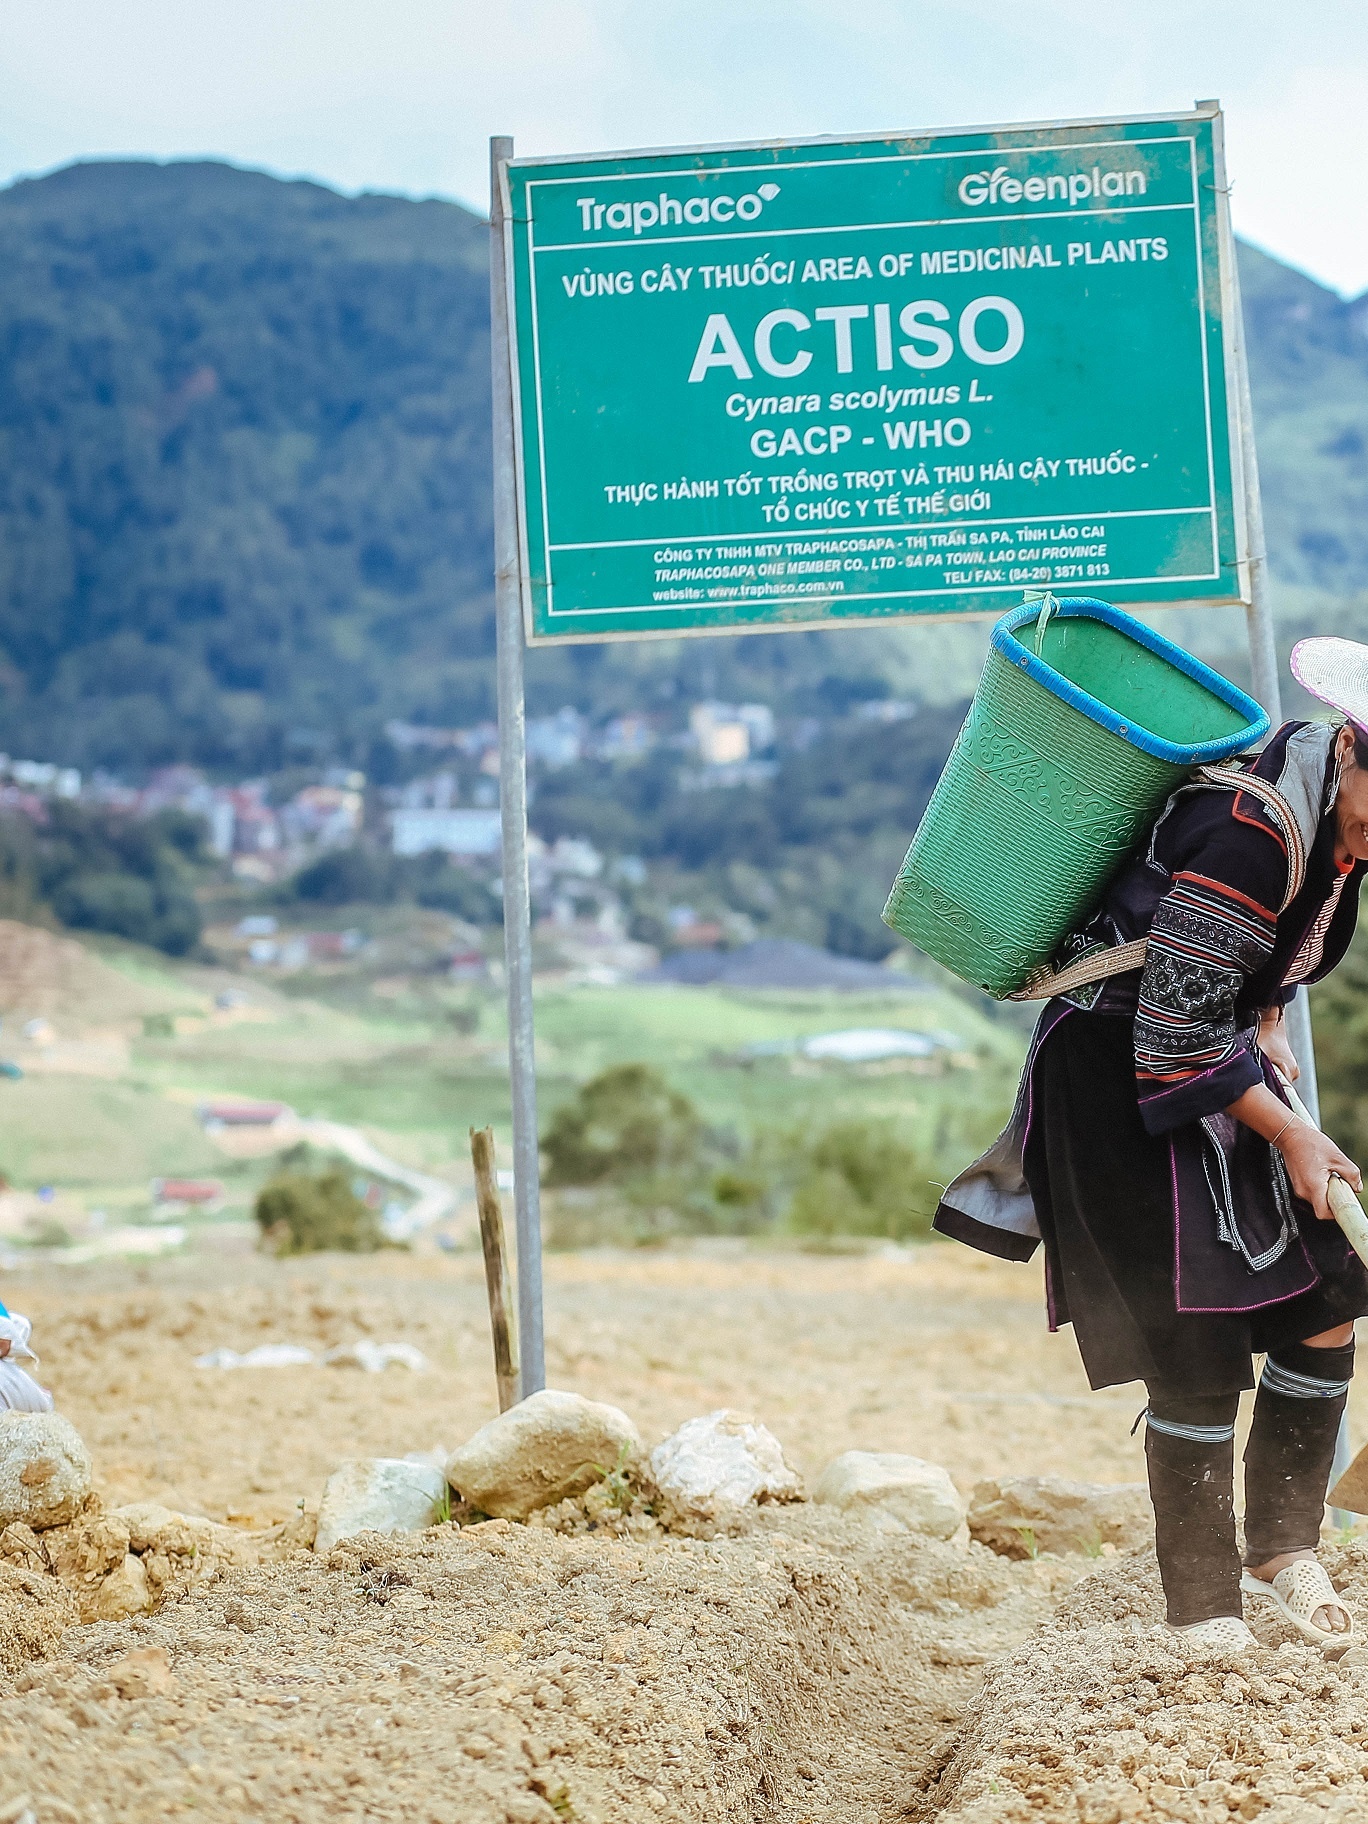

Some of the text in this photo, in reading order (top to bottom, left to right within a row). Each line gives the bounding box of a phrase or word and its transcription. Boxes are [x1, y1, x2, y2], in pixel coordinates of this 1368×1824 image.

[958, 166, 1147, 206] Greenplan
[577, 193, 763, 234] Traphaco
[562, 237, 1169, 298] VÙNG CÂY THUỐC/ AREA OF MEDICINAL PLANTS
[688, 295, 1025, 383] ACTISO
[726, 379, 994, 422] Cynara scolymus L.
[750, 425, 852, 458] GACP
[883, 417, 972, 450] WHO
[604, 482, 658, 507] THỰC
[663, 476, 719, 500] HÀNH
[723, 471, 763, 497] TỐT
[767, 467, 838, 494] TRỒNG
[843, 469, 897, 492] TRỌT
[901, 462, 930, 486] VÀ
[933, 465, 974, 485] THU
[980, 458, 1014, 481] HÁI
[1019, 457, 1060, 479] CÂY
[1065, 449, 1136, 476] THUỐC
[761, 488, 991, 523] TỔ CHỨC Y TẾ THẾ GIỚI
[653, 547, 693, 563] CÔNG
[695, 548, 713, 560] TY
[715, 546, 752, 560] TNHH
[754, 544, 783, 557] MTV
[784, 537, 895, 556] TRAPHACOSAPA
[904, 535, 927, 551] THỊ
[929, 529, 966, 547] TRẤN
[969, 532, 988, 545] SA
[990, 530, 1014, 544] PA,
[1081, 525, 1105, 539] CAI
[654, 565, 755, 582] TRAPHACOSAPA
[758, 562, 785, 576] ONE
[787, 559, 840, 575] MEMBER
[871, 556, 896, 570] LTD
[905, 554, 922, 568] SA
[925, 553, 943, 567] PA
[989, 549, 1016, 563] LAO
[1018, 548, 1040, 561] CAI
[1042, 544, 1107, 560] PROVINCE
[653, 580, 844, 601] website: www.traphaco.com.vn
[975, 568, 1006, 582] FAX:
[1054, 564, 1083, 578] 3871
[1086, 563, 1110, 576] 813
